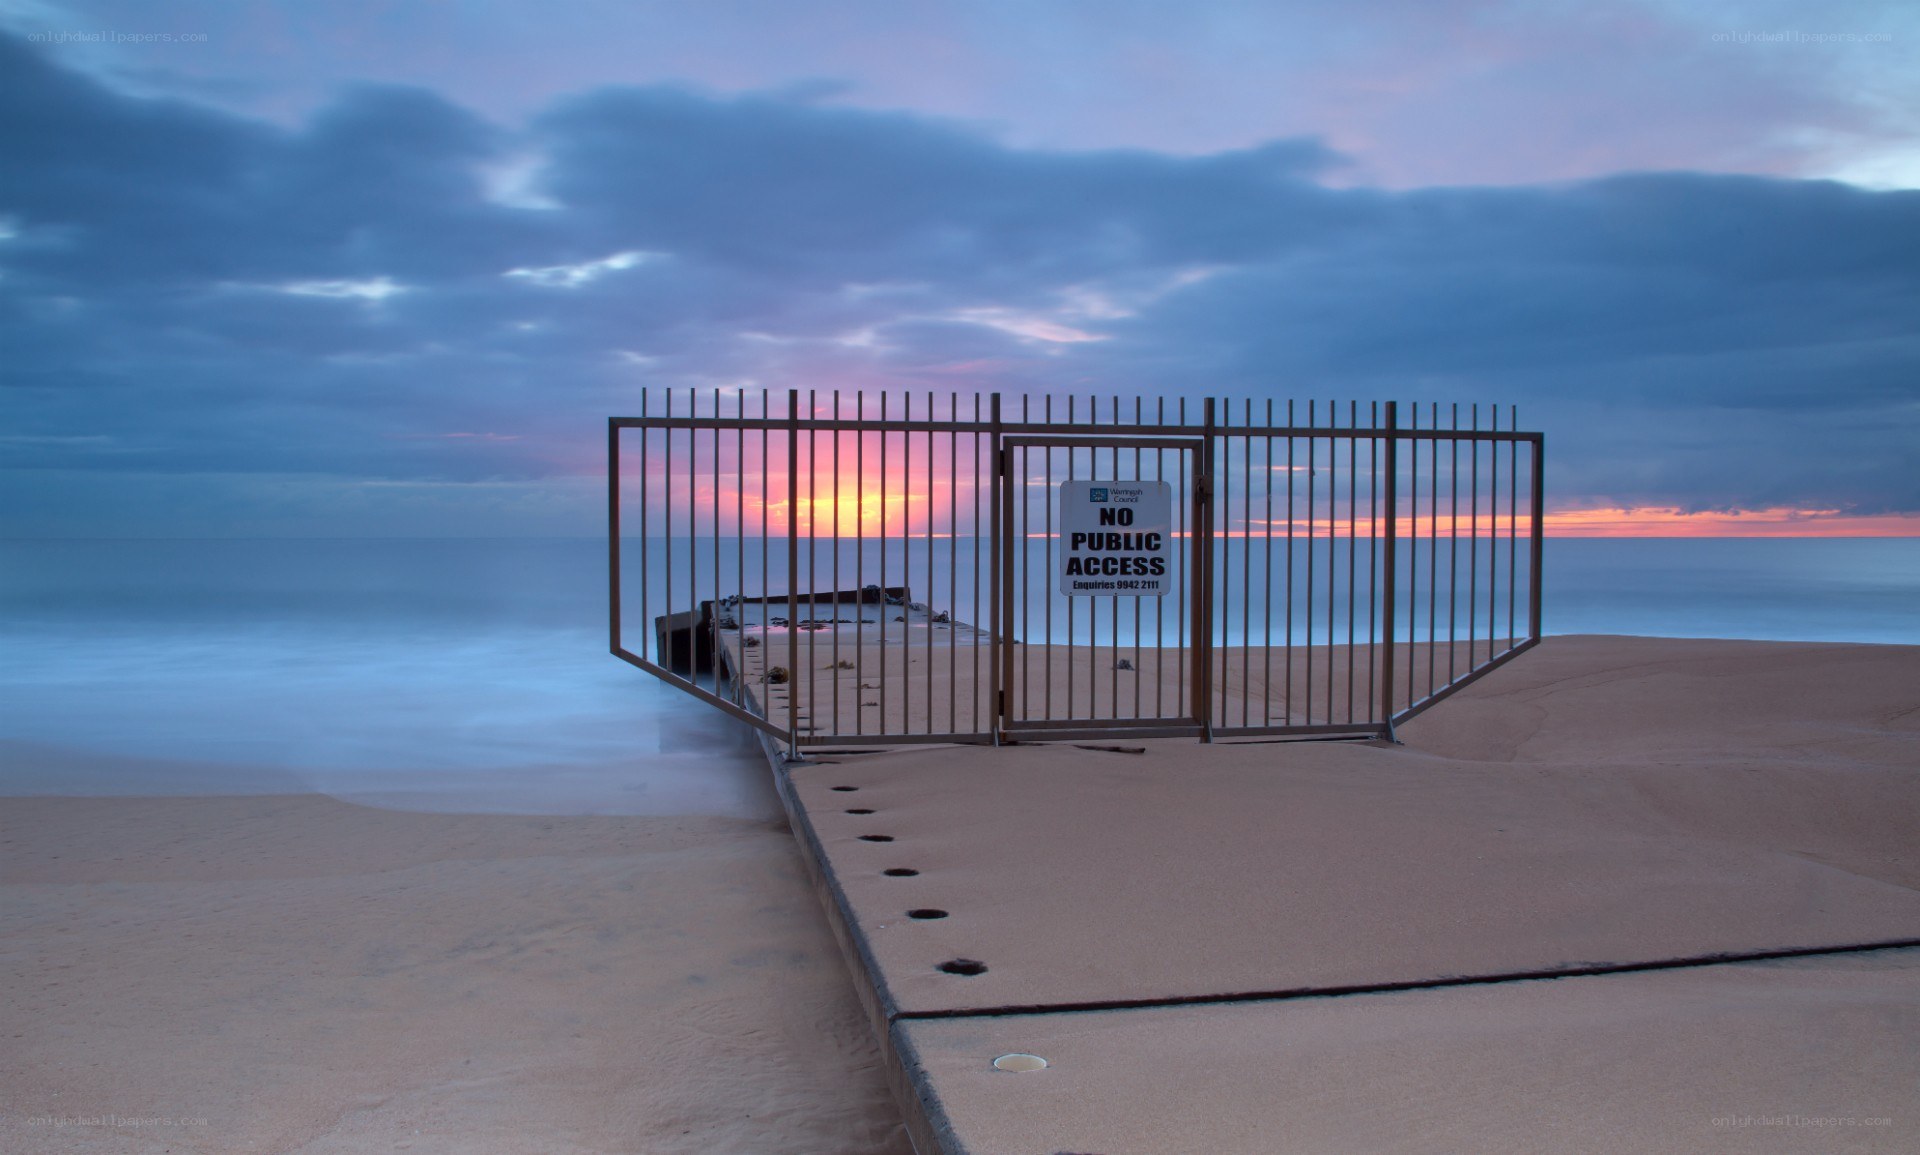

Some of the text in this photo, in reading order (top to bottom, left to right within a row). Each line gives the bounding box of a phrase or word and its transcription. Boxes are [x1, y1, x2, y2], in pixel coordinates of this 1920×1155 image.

[1100, 507, 1133, 526] NO
[1071, 532, 1161, 551] PUBLIC
[1066, 556, 1165, 576] ACCESS
[1073, 580, 1159, 590] Enquiries 9942 2111
